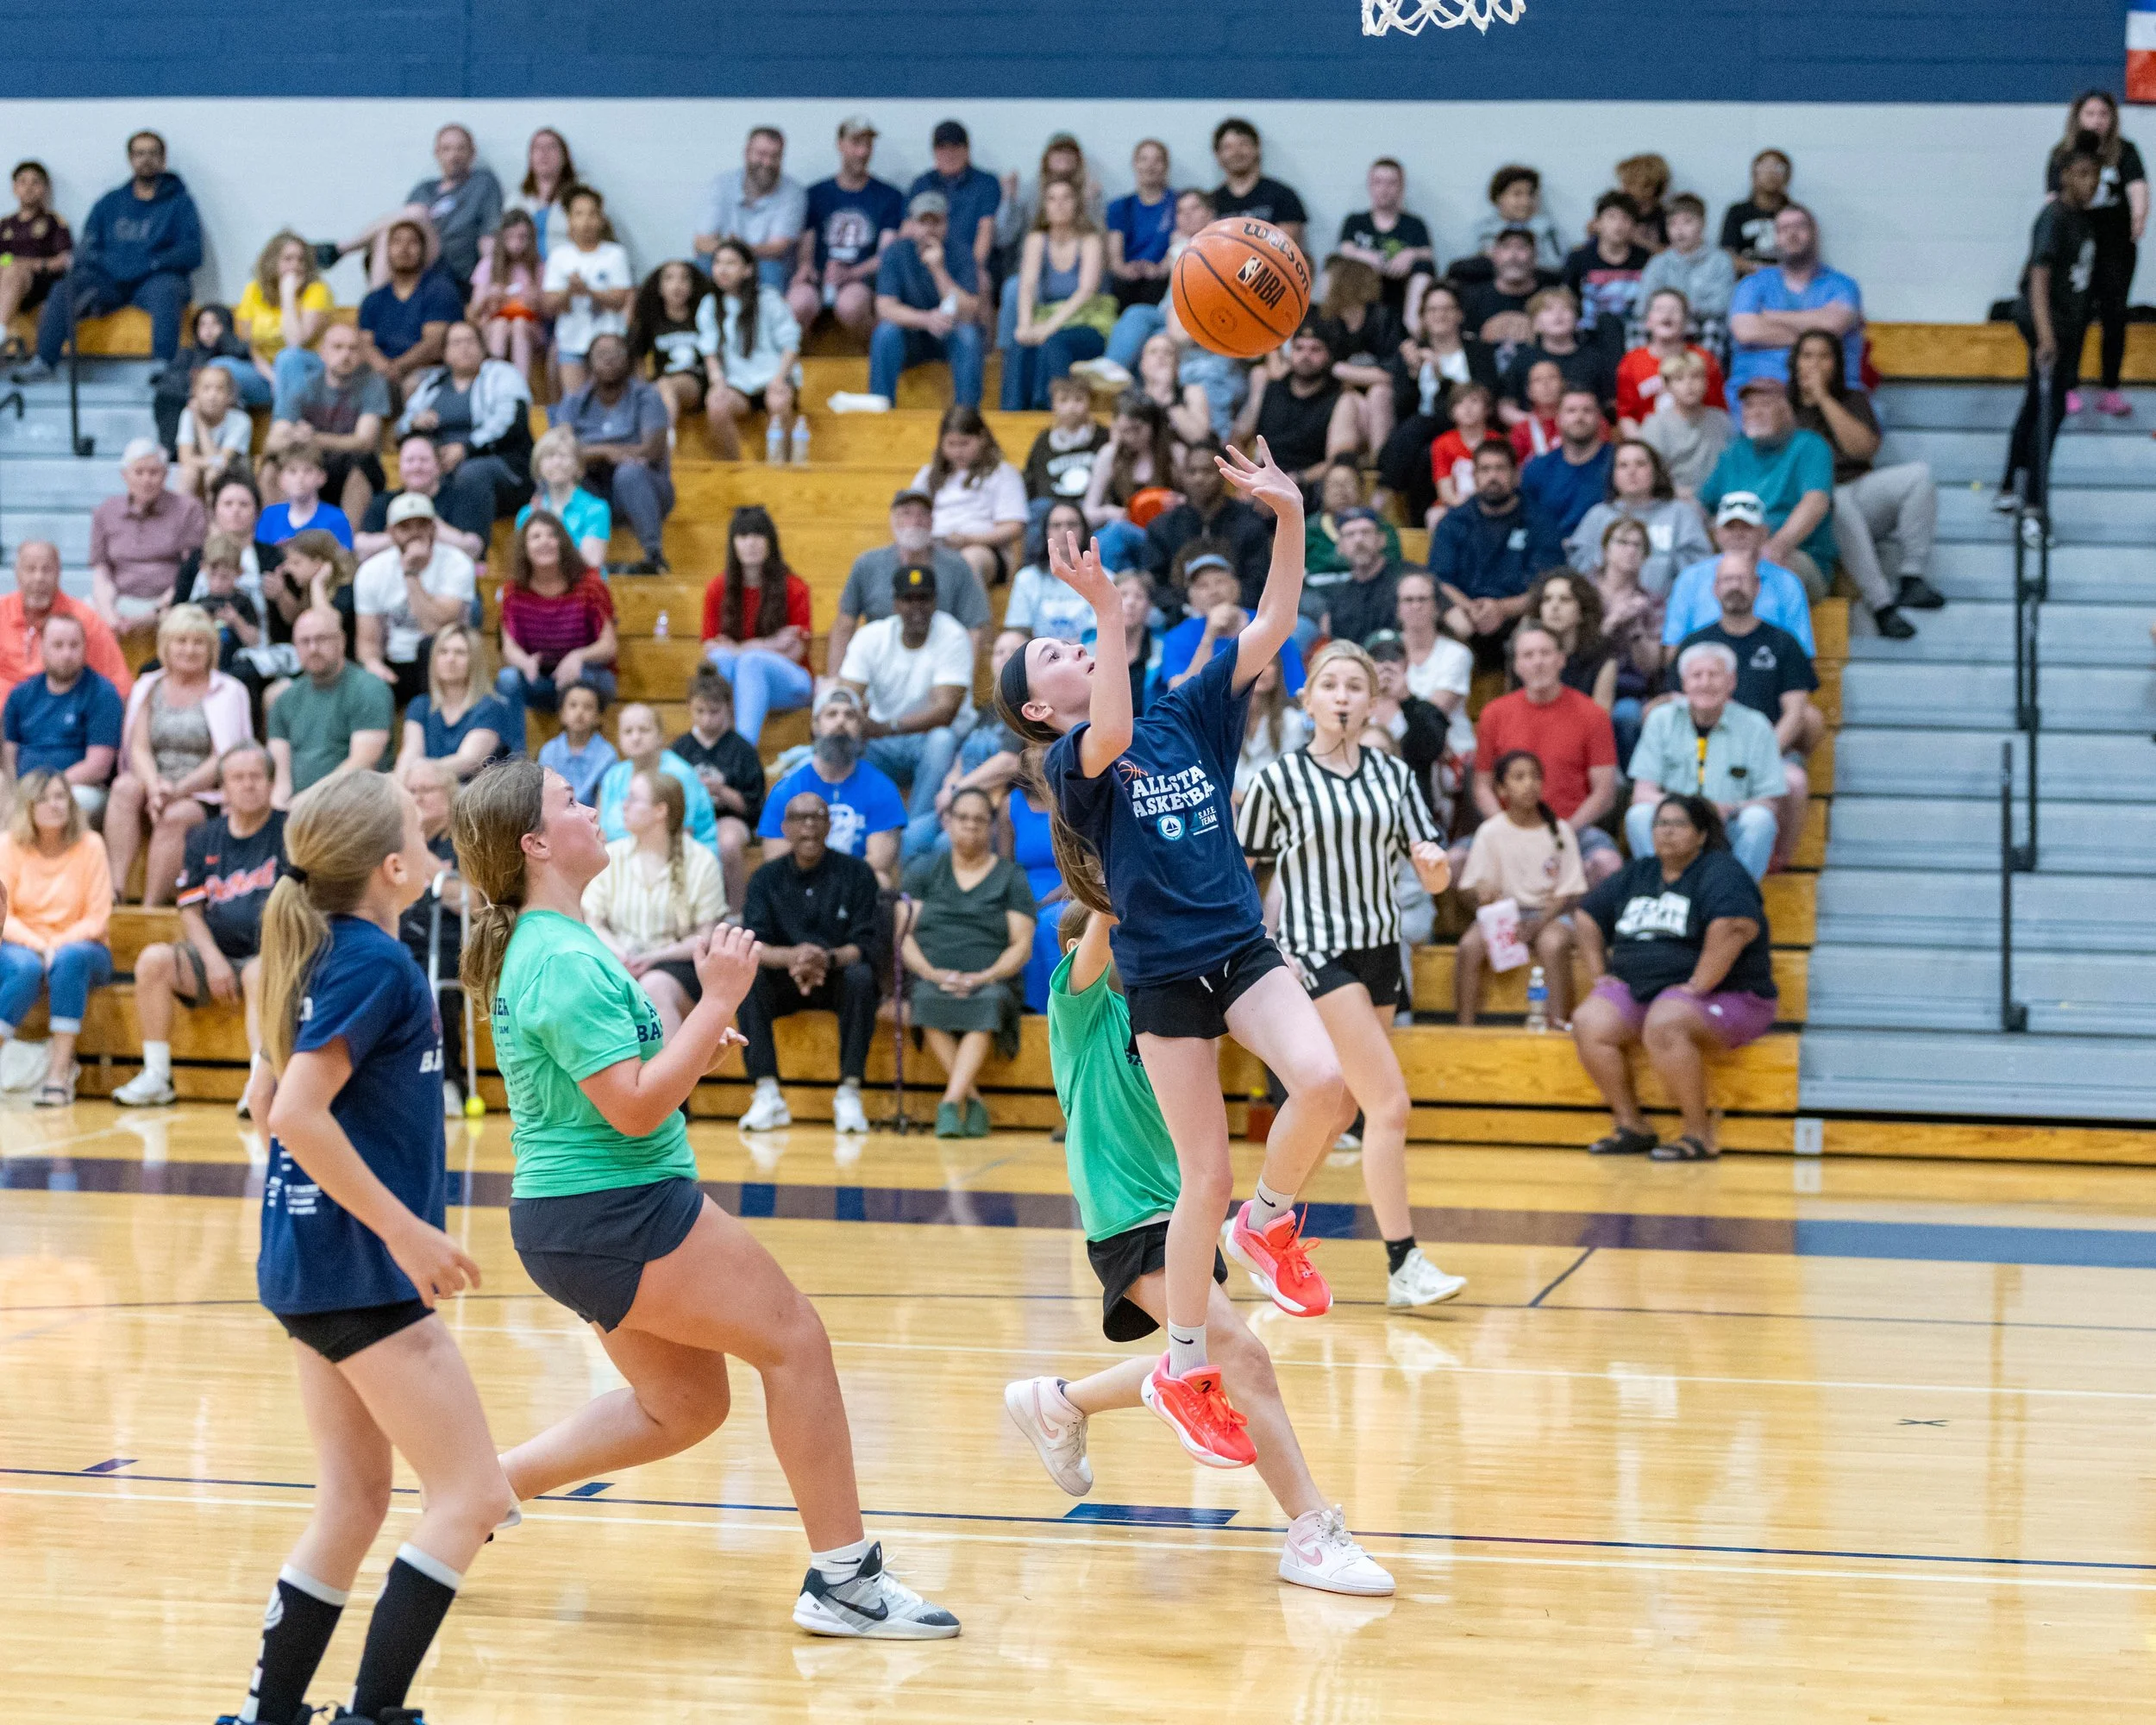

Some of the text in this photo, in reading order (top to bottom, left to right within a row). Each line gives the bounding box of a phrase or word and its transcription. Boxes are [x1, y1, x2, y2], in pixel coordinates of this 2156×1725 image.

[1250, 266, 1286, 310] NBA
[1132, 760, 1206, 799] ALLSTA
[1132, 781, 1216, 818] ASKETBA
[1200, 813, 1218, 826] TEAM
[636, 1019, 663, 1043] BA
